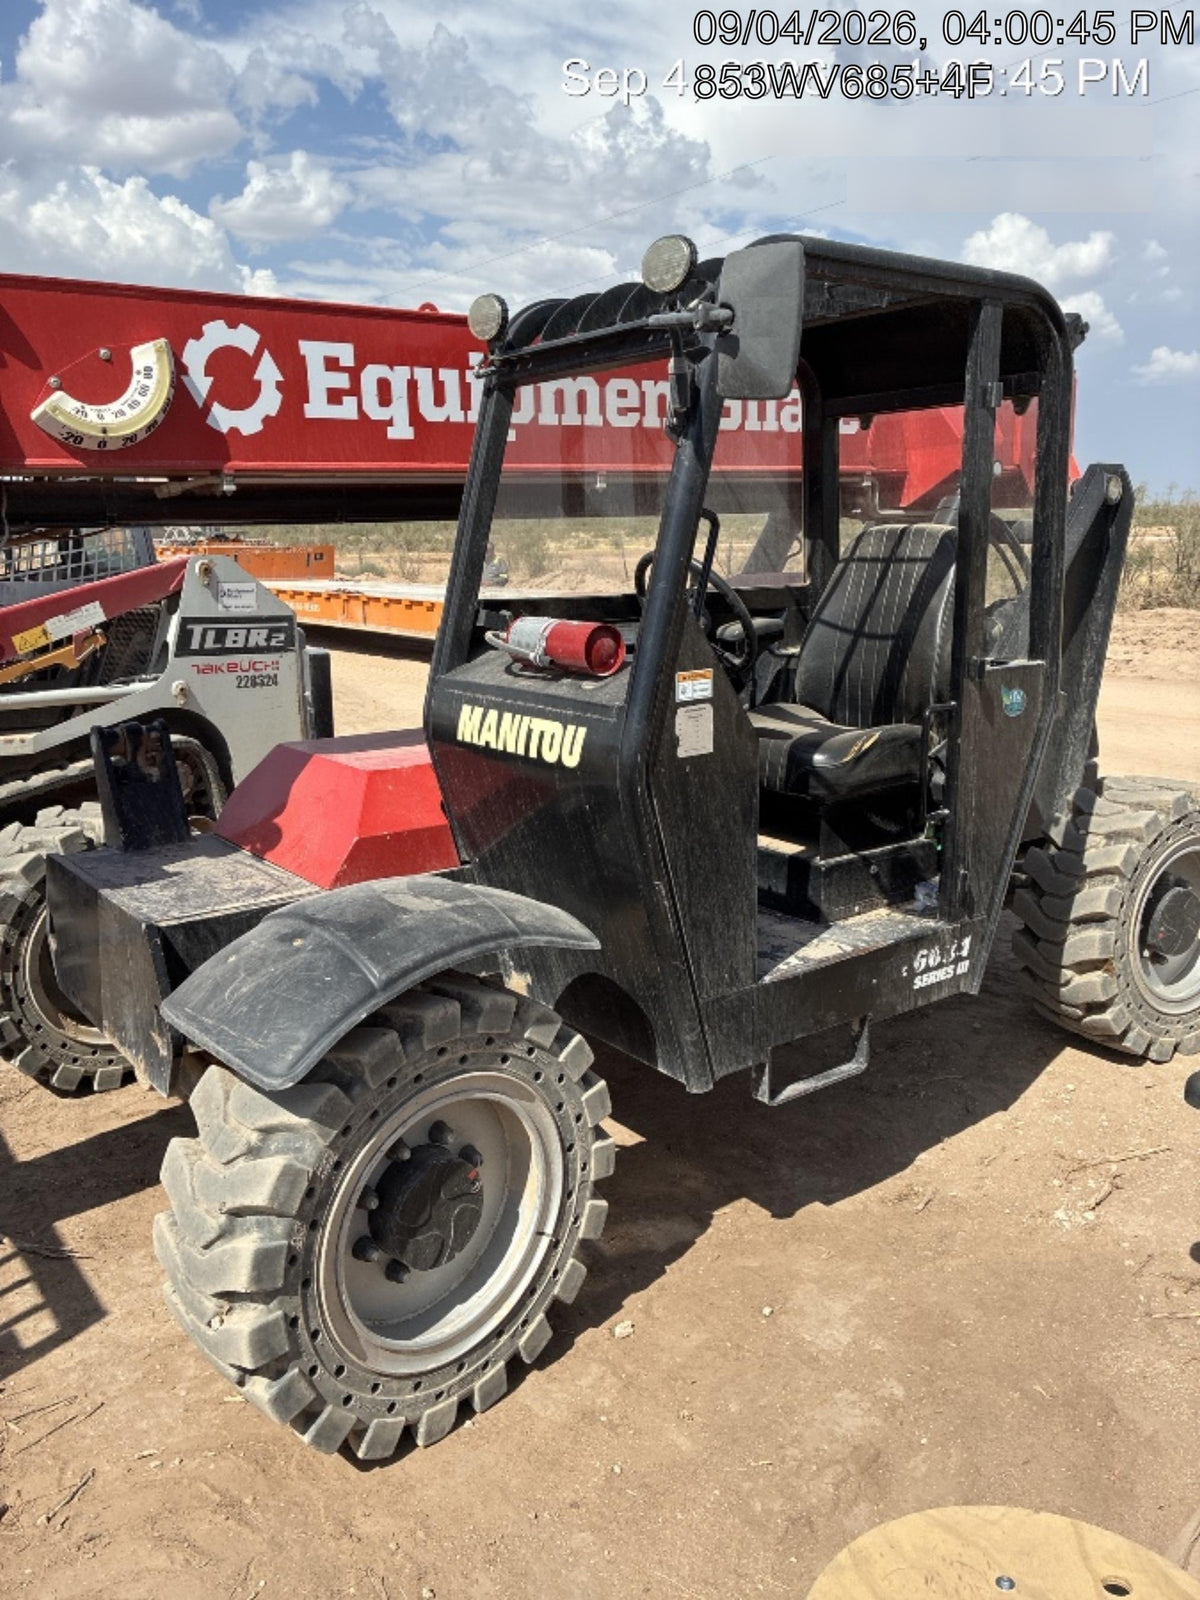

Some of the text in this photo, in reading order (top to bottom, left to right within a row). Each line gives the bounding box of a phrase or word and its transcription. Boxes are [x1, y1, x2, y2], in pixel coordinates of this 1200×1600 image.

[298, 339, 861, 440] Equipmenha
[456, 703, 588, 769] MANITOU
[913, 964, 956, 989] SERIES
